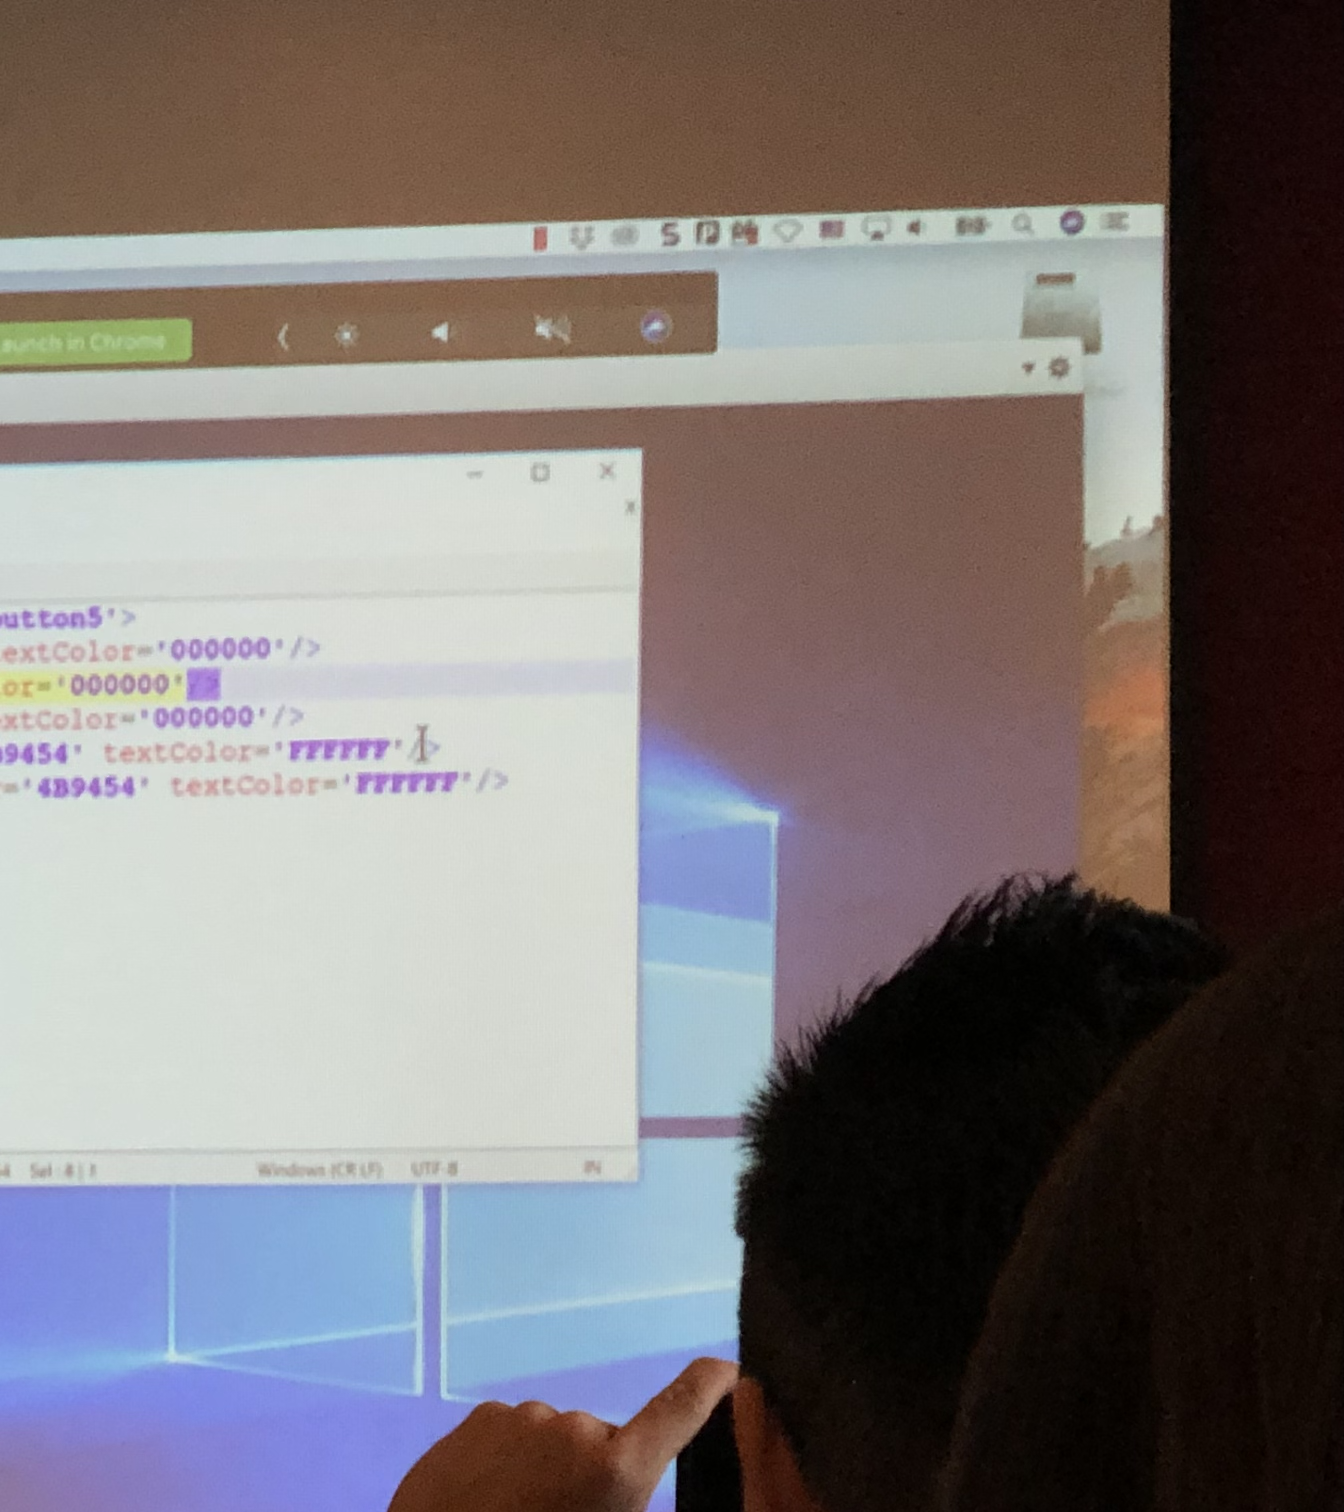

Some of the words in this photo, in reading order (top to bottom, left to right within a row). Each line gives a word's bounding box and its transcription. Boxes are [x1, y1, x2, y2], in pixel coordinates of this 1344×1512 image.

[67, 333, 85, 352] in
[90, 332, 167, 352] Chrome
[257, 1160, 326, 1178] Windows
[411, 1160, 459, 1178] UTF-8
